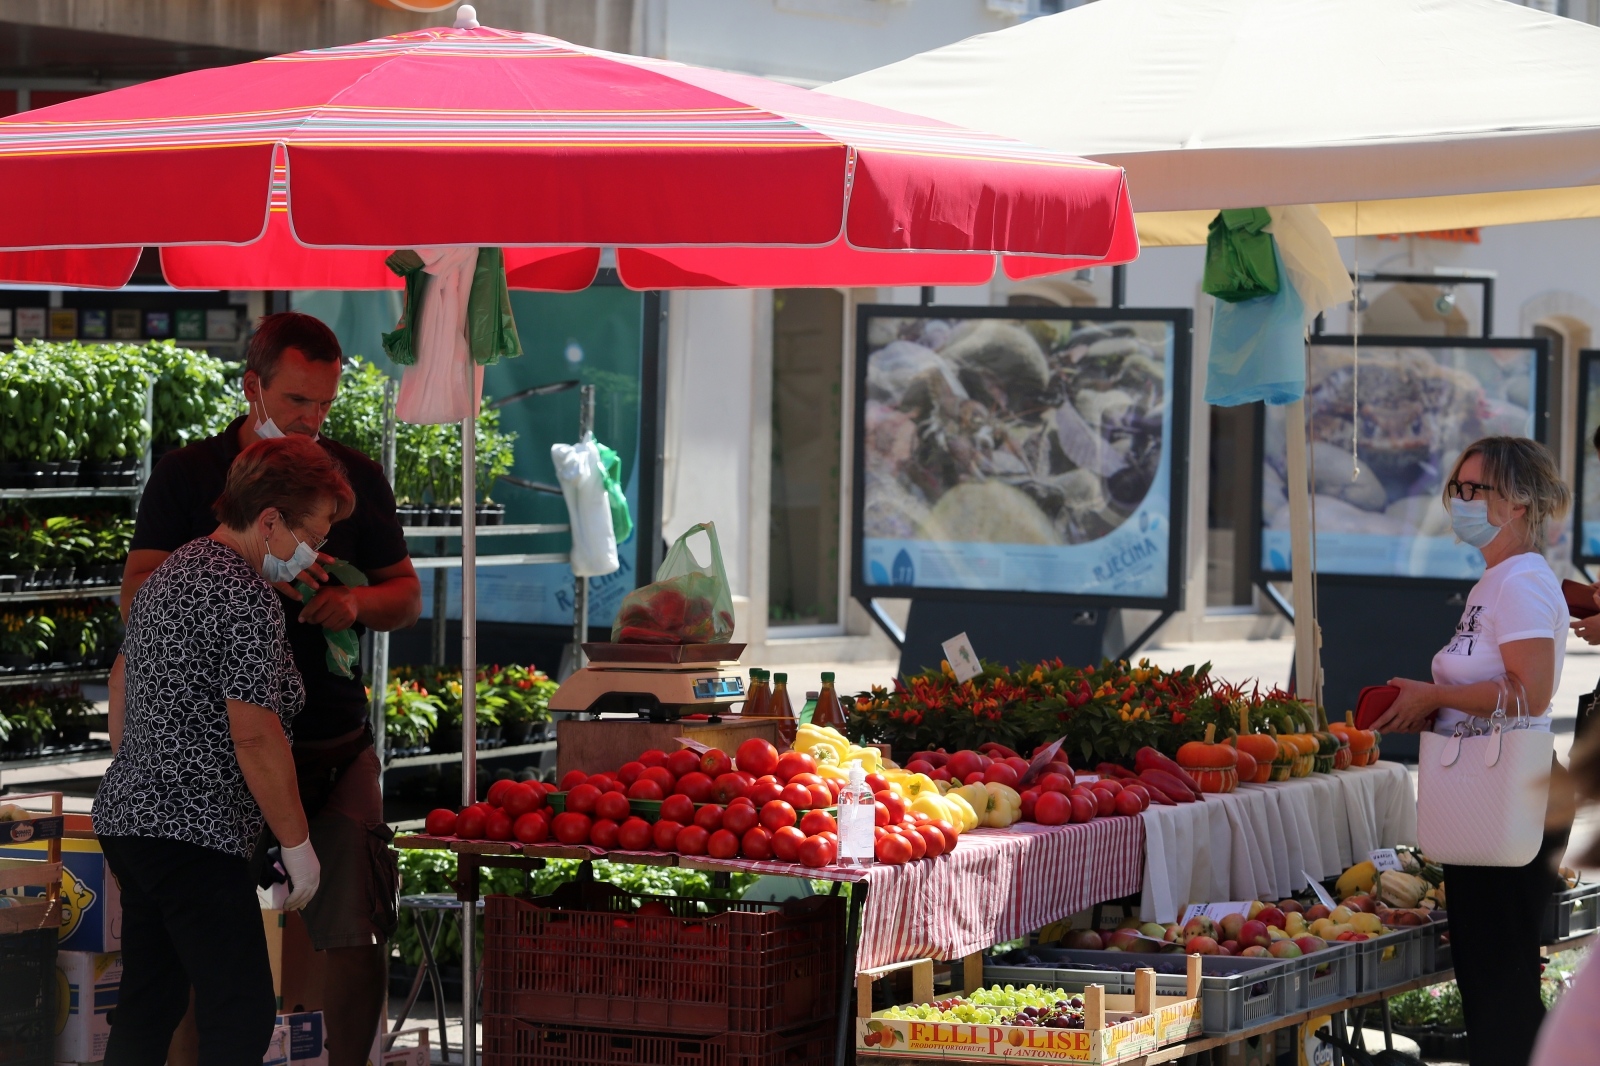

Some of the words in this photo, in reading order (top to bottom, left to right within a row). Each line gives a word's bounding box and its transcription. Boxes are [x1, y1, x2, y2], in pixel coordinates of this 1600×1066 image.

[909, 1022, 979, 1045] F.LLI
[910, 1042, 945, 1050] PRODOTTI
[1003, 1048, 1012, 1056] di
[1014, 1049, 1067, 1060] ANTONIO
